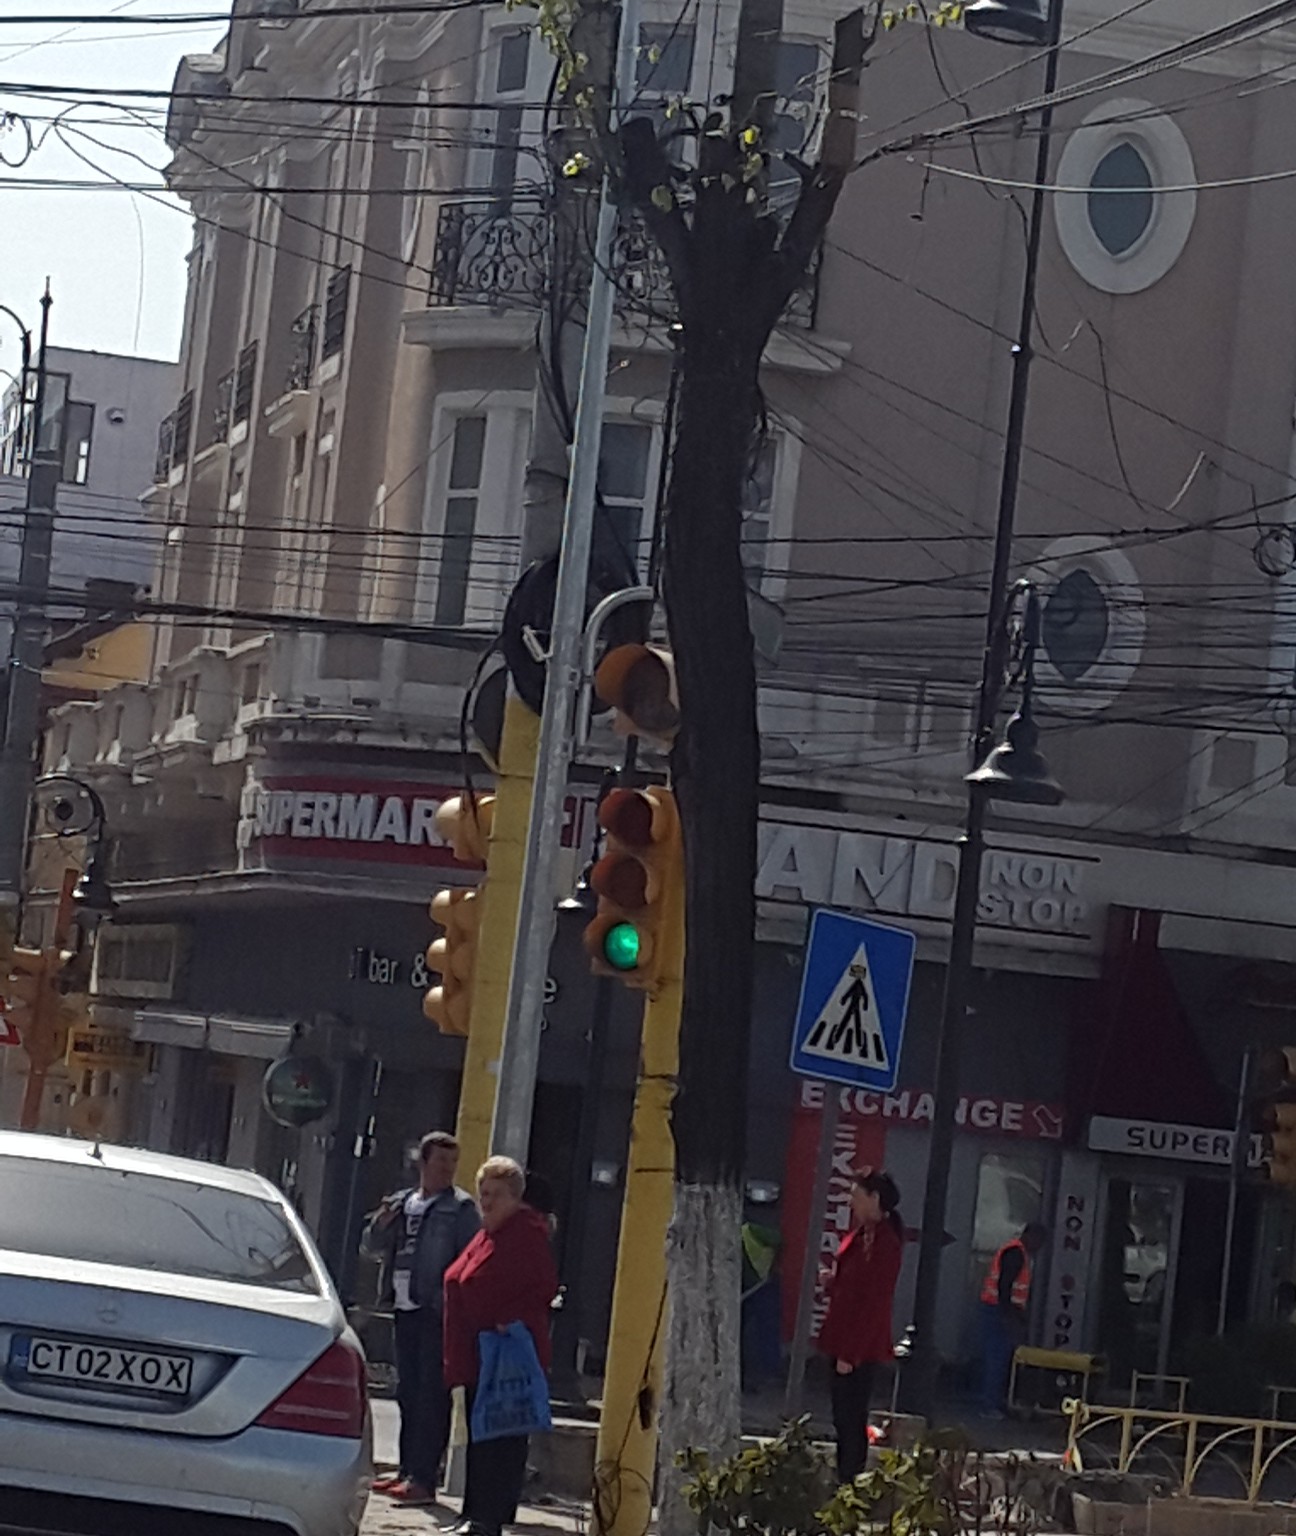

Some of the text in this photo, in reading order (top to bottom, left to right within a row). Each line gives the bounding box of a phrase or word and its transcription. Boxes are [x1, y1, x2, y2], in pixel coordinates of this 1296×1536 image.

[252, 790, 456, 848] SUPERMAR
[990, 855, 1084, 895] NON
[976, 892, 1091, 930] STOP
[368, 950, 399, 985] bar
[411, 952, 429, 988] &
[1063, 1195, 1085, 1252] NON
